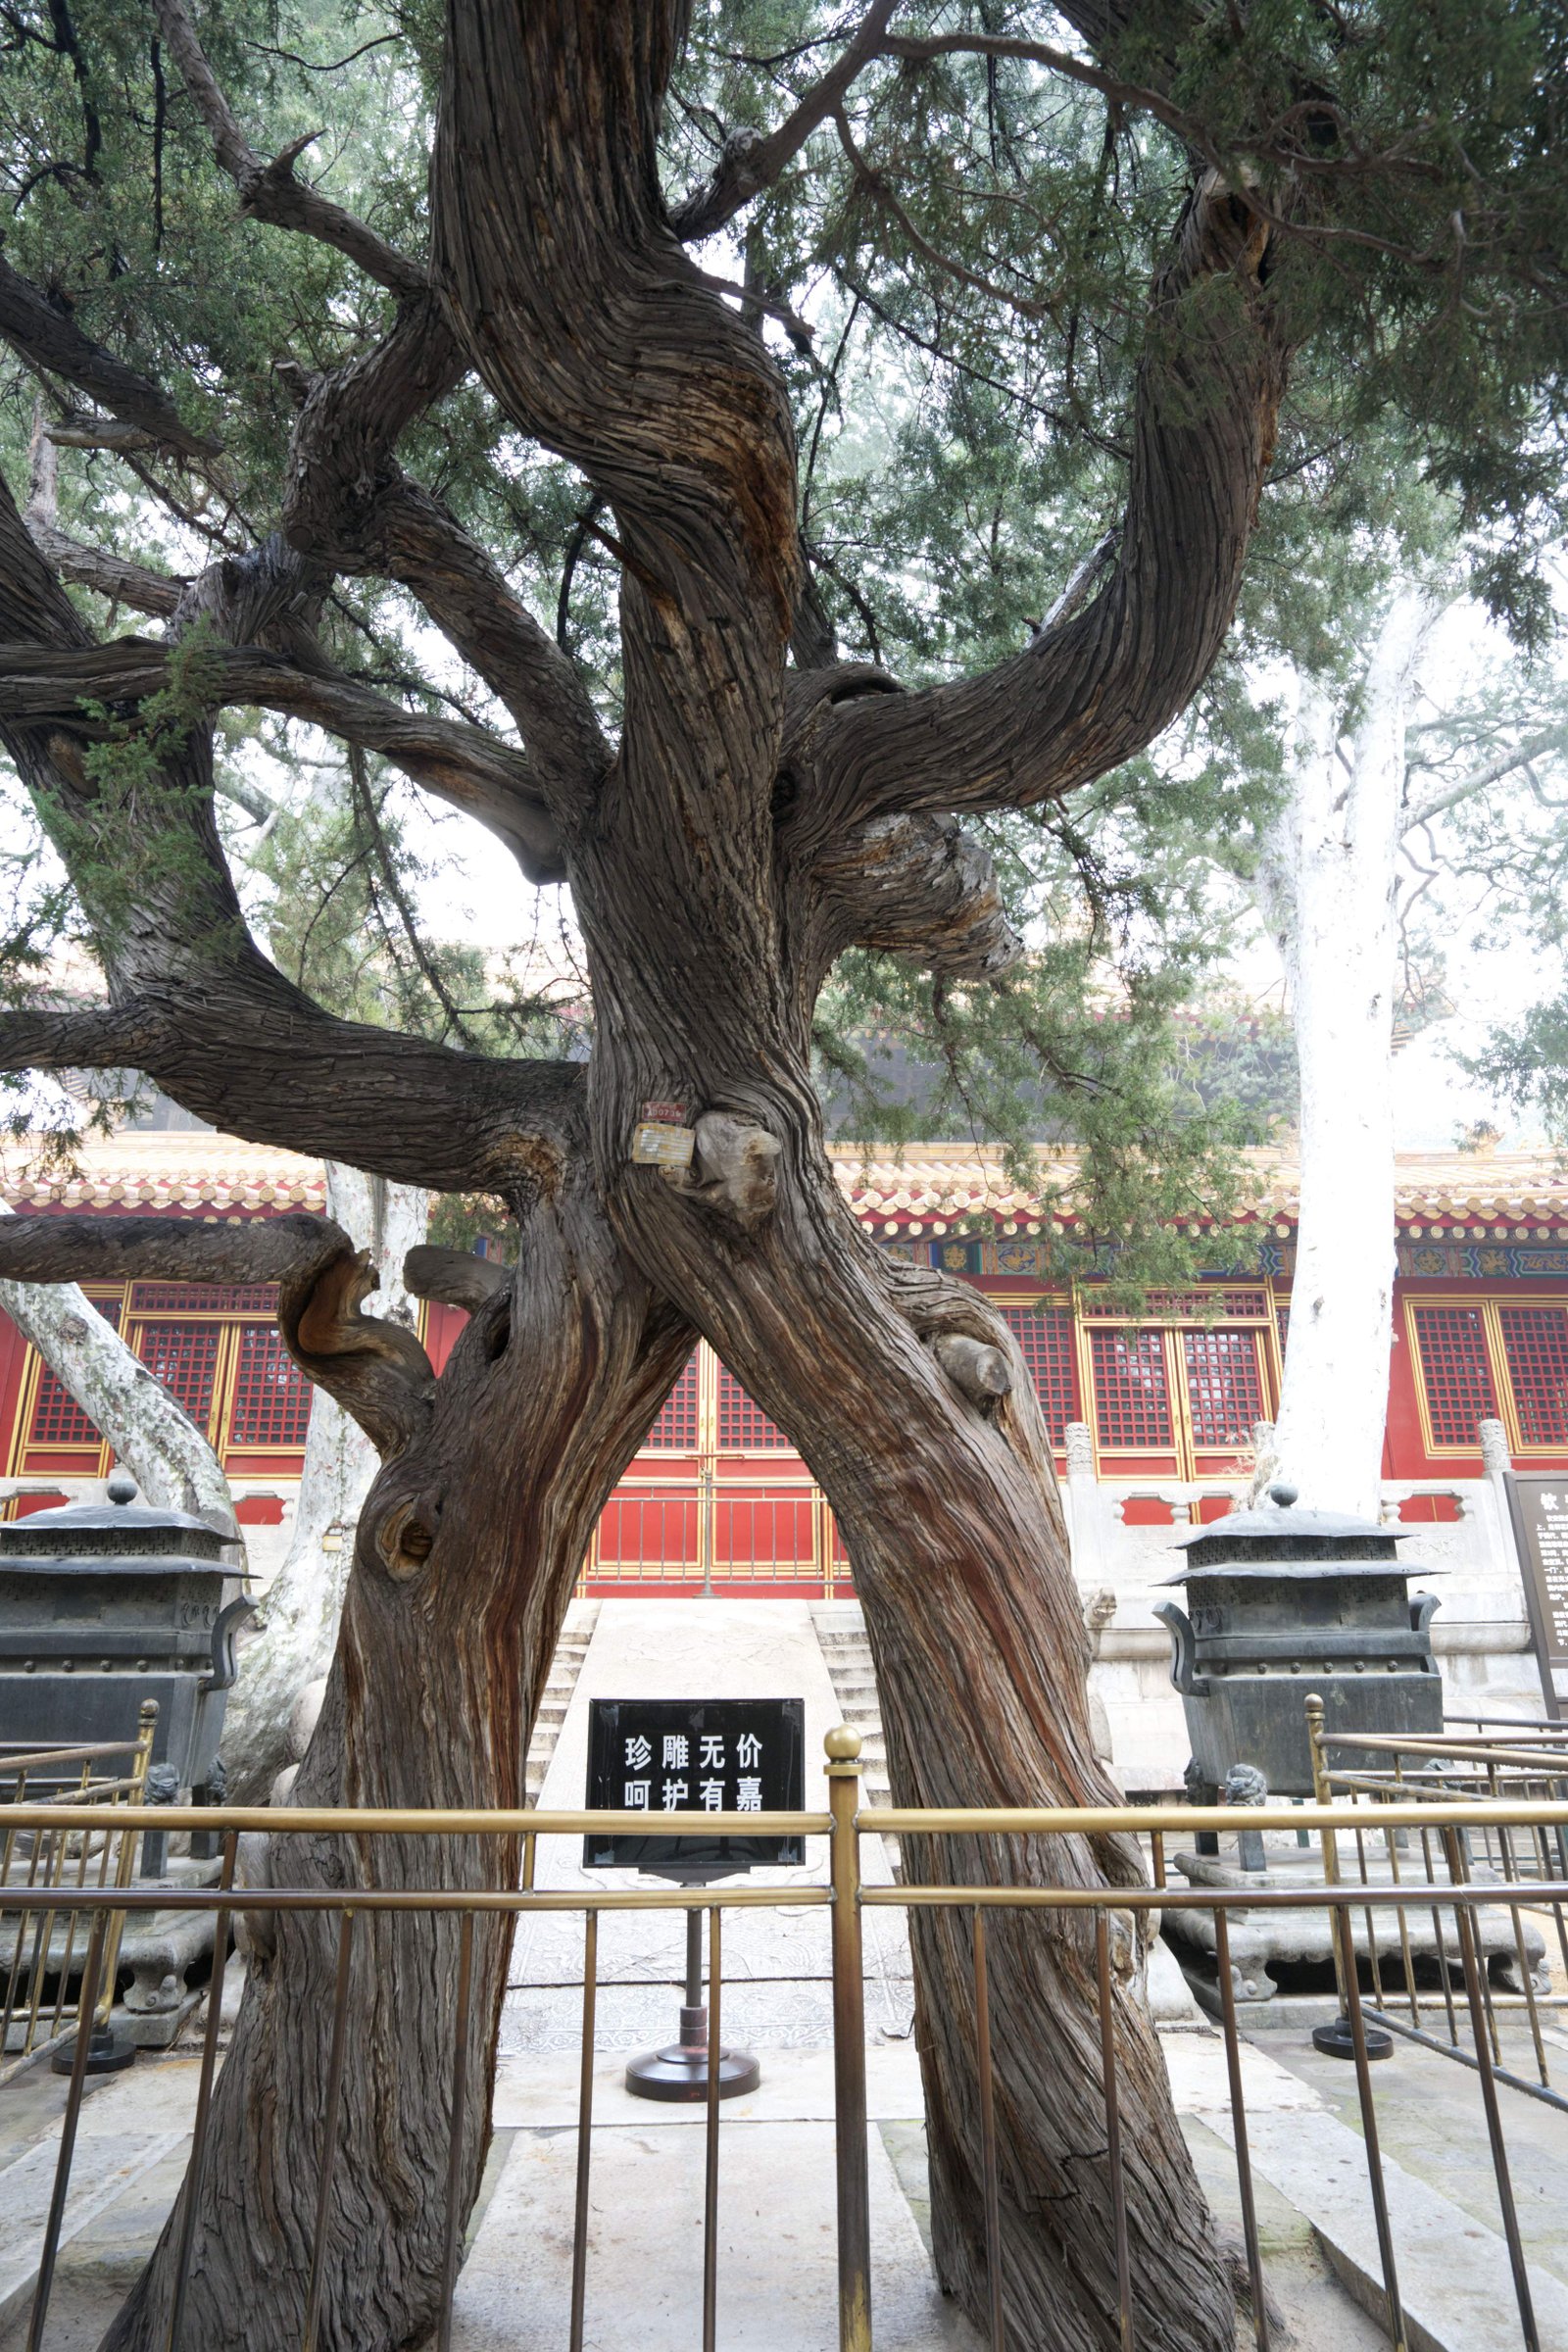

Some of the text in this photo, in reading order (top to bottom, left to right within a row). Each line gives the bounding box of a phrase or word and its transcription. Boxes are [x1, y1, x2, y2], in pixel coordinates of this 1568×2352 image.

[624, 1733, 762, 1771] 珍雕无价
[624, 1776, 762, 1812] 呵护有嘉
